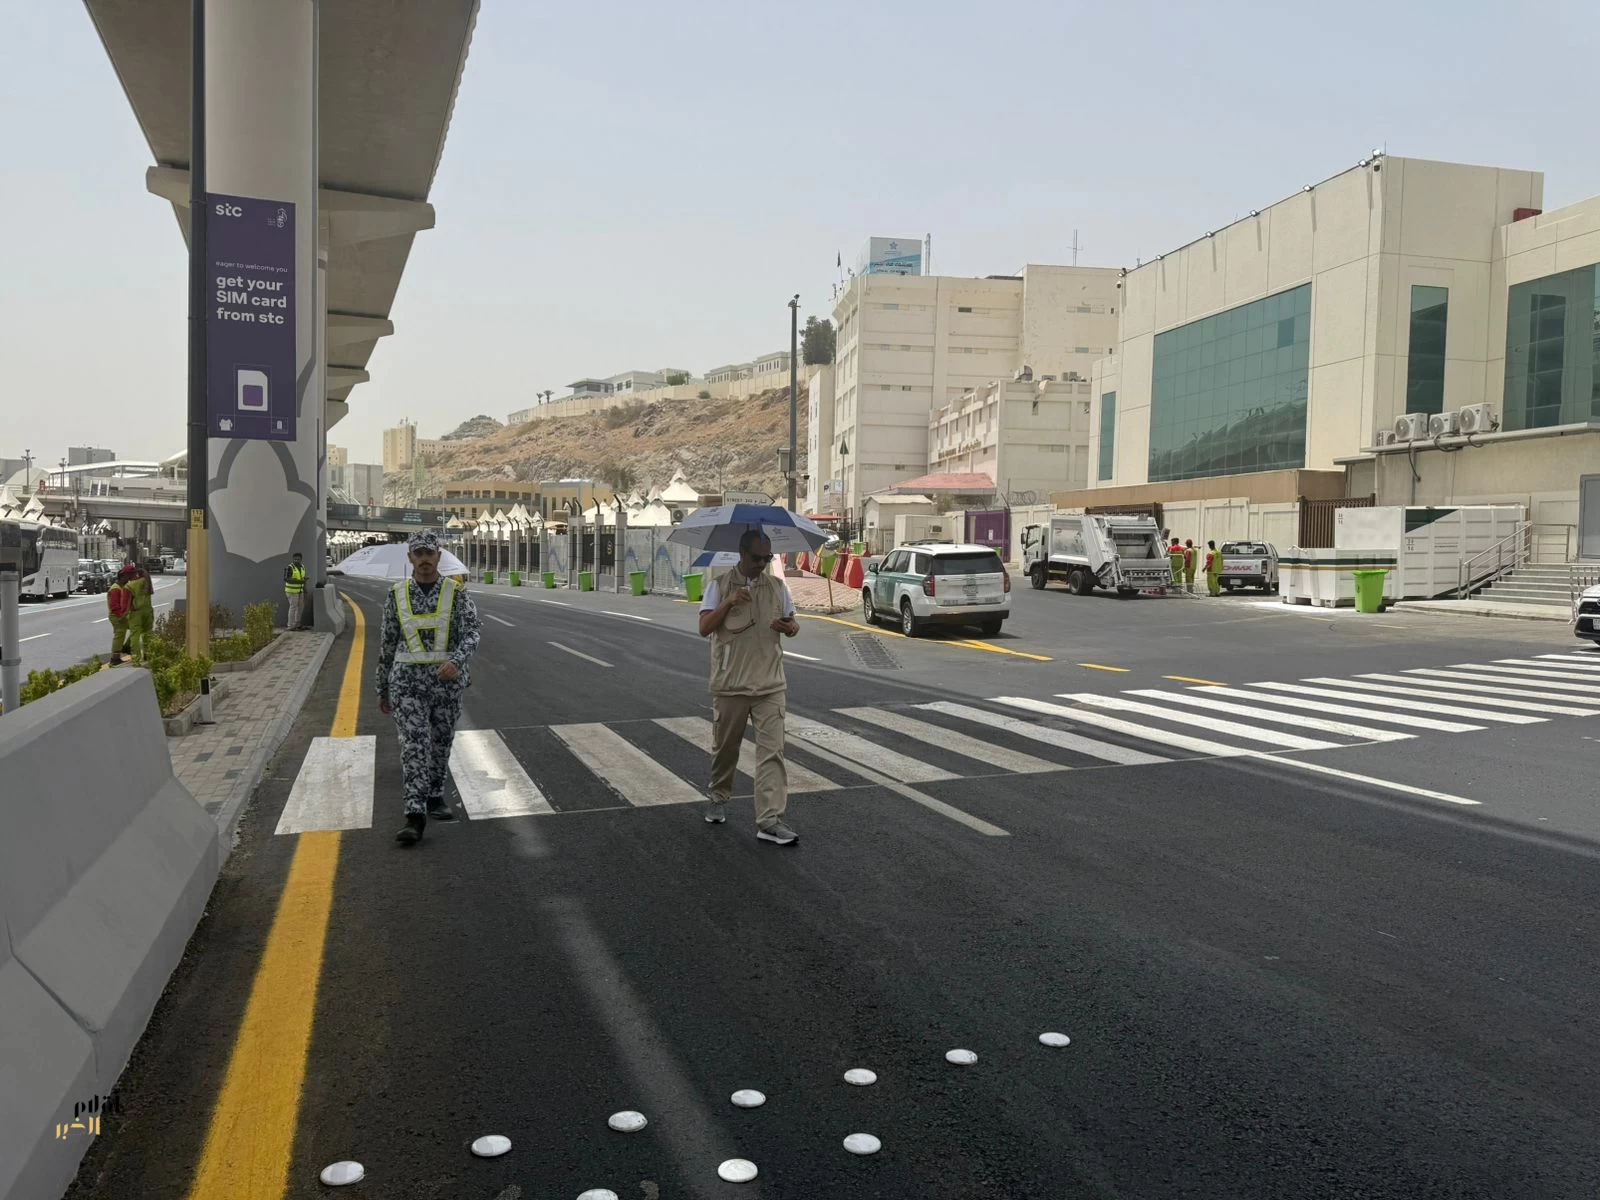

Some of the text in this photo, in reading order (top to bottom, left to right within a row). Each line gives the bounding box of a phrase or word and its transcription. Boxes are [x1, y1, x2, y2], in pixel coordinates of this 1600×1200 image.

[215, 203, 243, 217] stc
[245, 263, 275, 272] welcome
[216, 276, 283, 291] get your
[216, 290, 287, 308] SIM card
[216, 307, 285, 325] from stc
